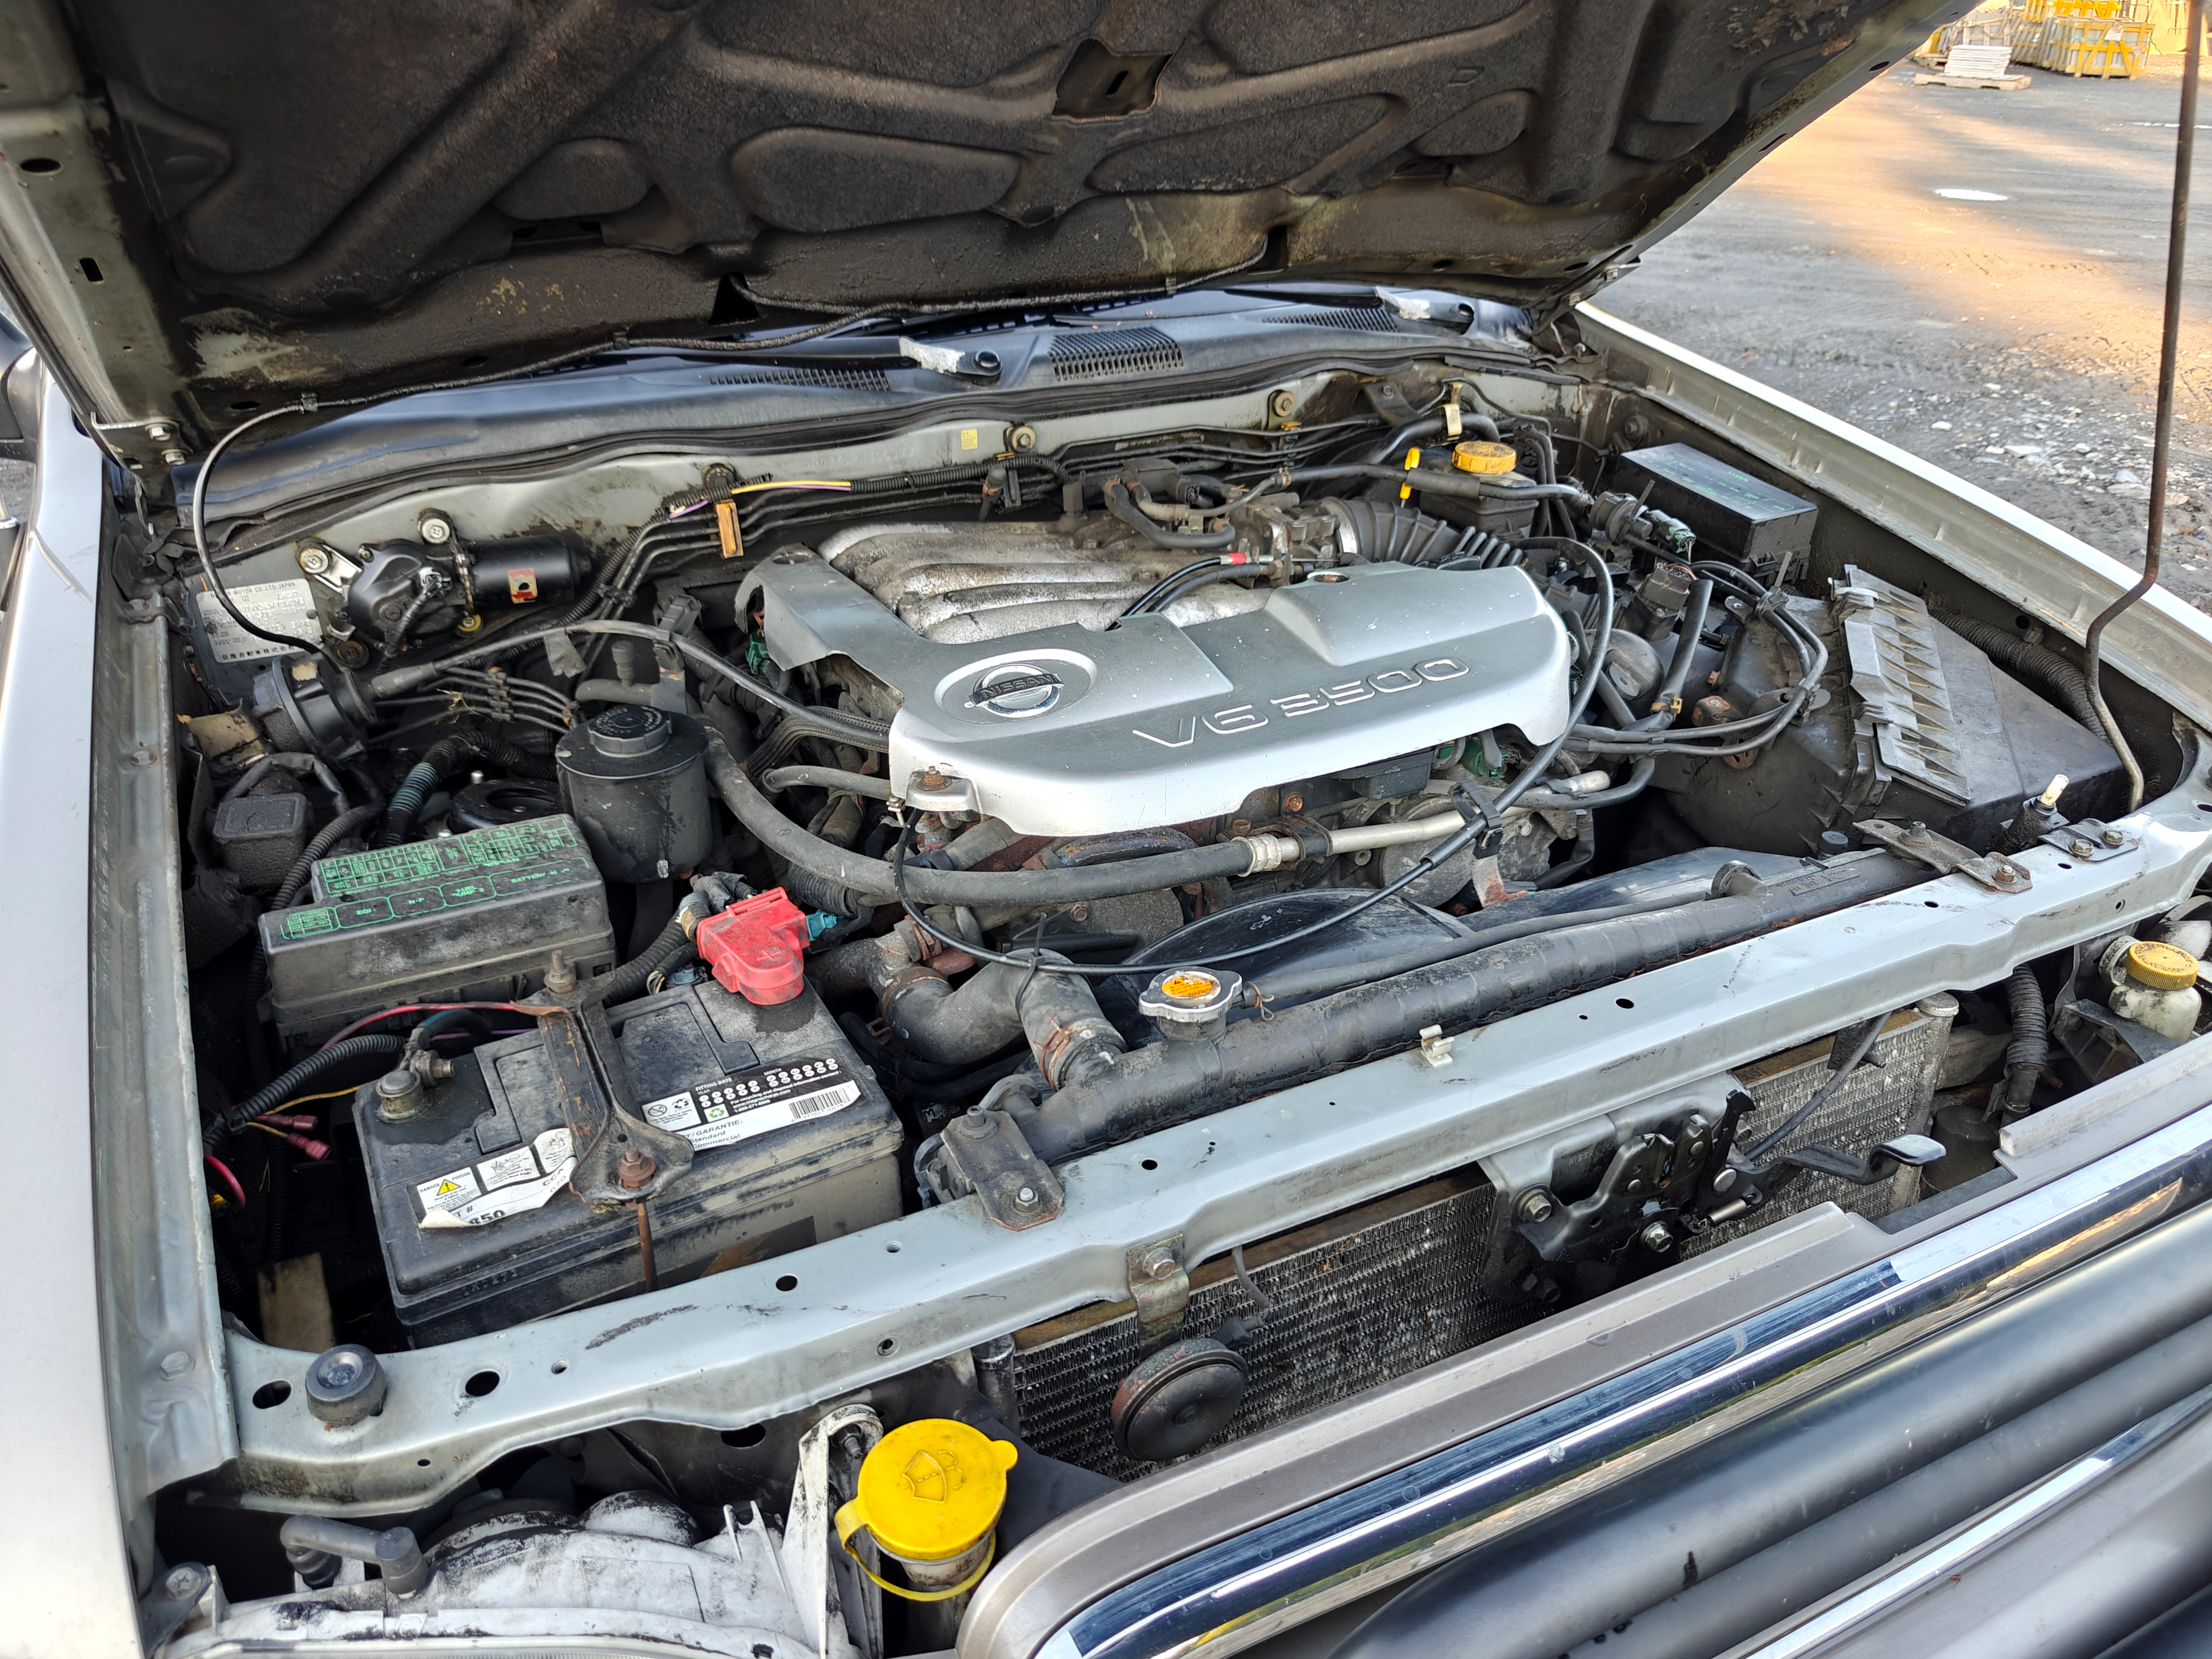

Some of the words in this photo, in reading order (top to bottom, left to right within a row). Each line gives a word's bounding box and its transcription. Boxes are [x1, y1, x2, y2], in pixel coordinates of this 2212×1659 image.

[233, 587, 253, 595] MOTOR
[279, 582, 296, 590] JAPAN
[980, 675, 1054, 700] NISSAN
[1132, 704, 1269, 748] V6
[1269, 658, 1470, 718] 3500
[482, 857, 521, 867] NISSAN
[510, 872, 546, 884] BATTERY
[763, 1067, 783, 1076] MONTH
[695, 1081, 718, 1091] FITTING
[717, 1077, 733, 1085] DATE
[740, 1092, 763, 1102] recycling
[772, 1083, 793, 1092] disposal
[793, 1076, 821, 1087] information
[690, 1130, 726, 1143] Standard
[693, 1133, 740, 1149] Commercial
[420, 1182, 441, 1193] DANGER
[451, 1171, 471, 1181] POISON
[542, 1168, 565, 1186] CCA
[550, 1175, 567, 1193] 670
